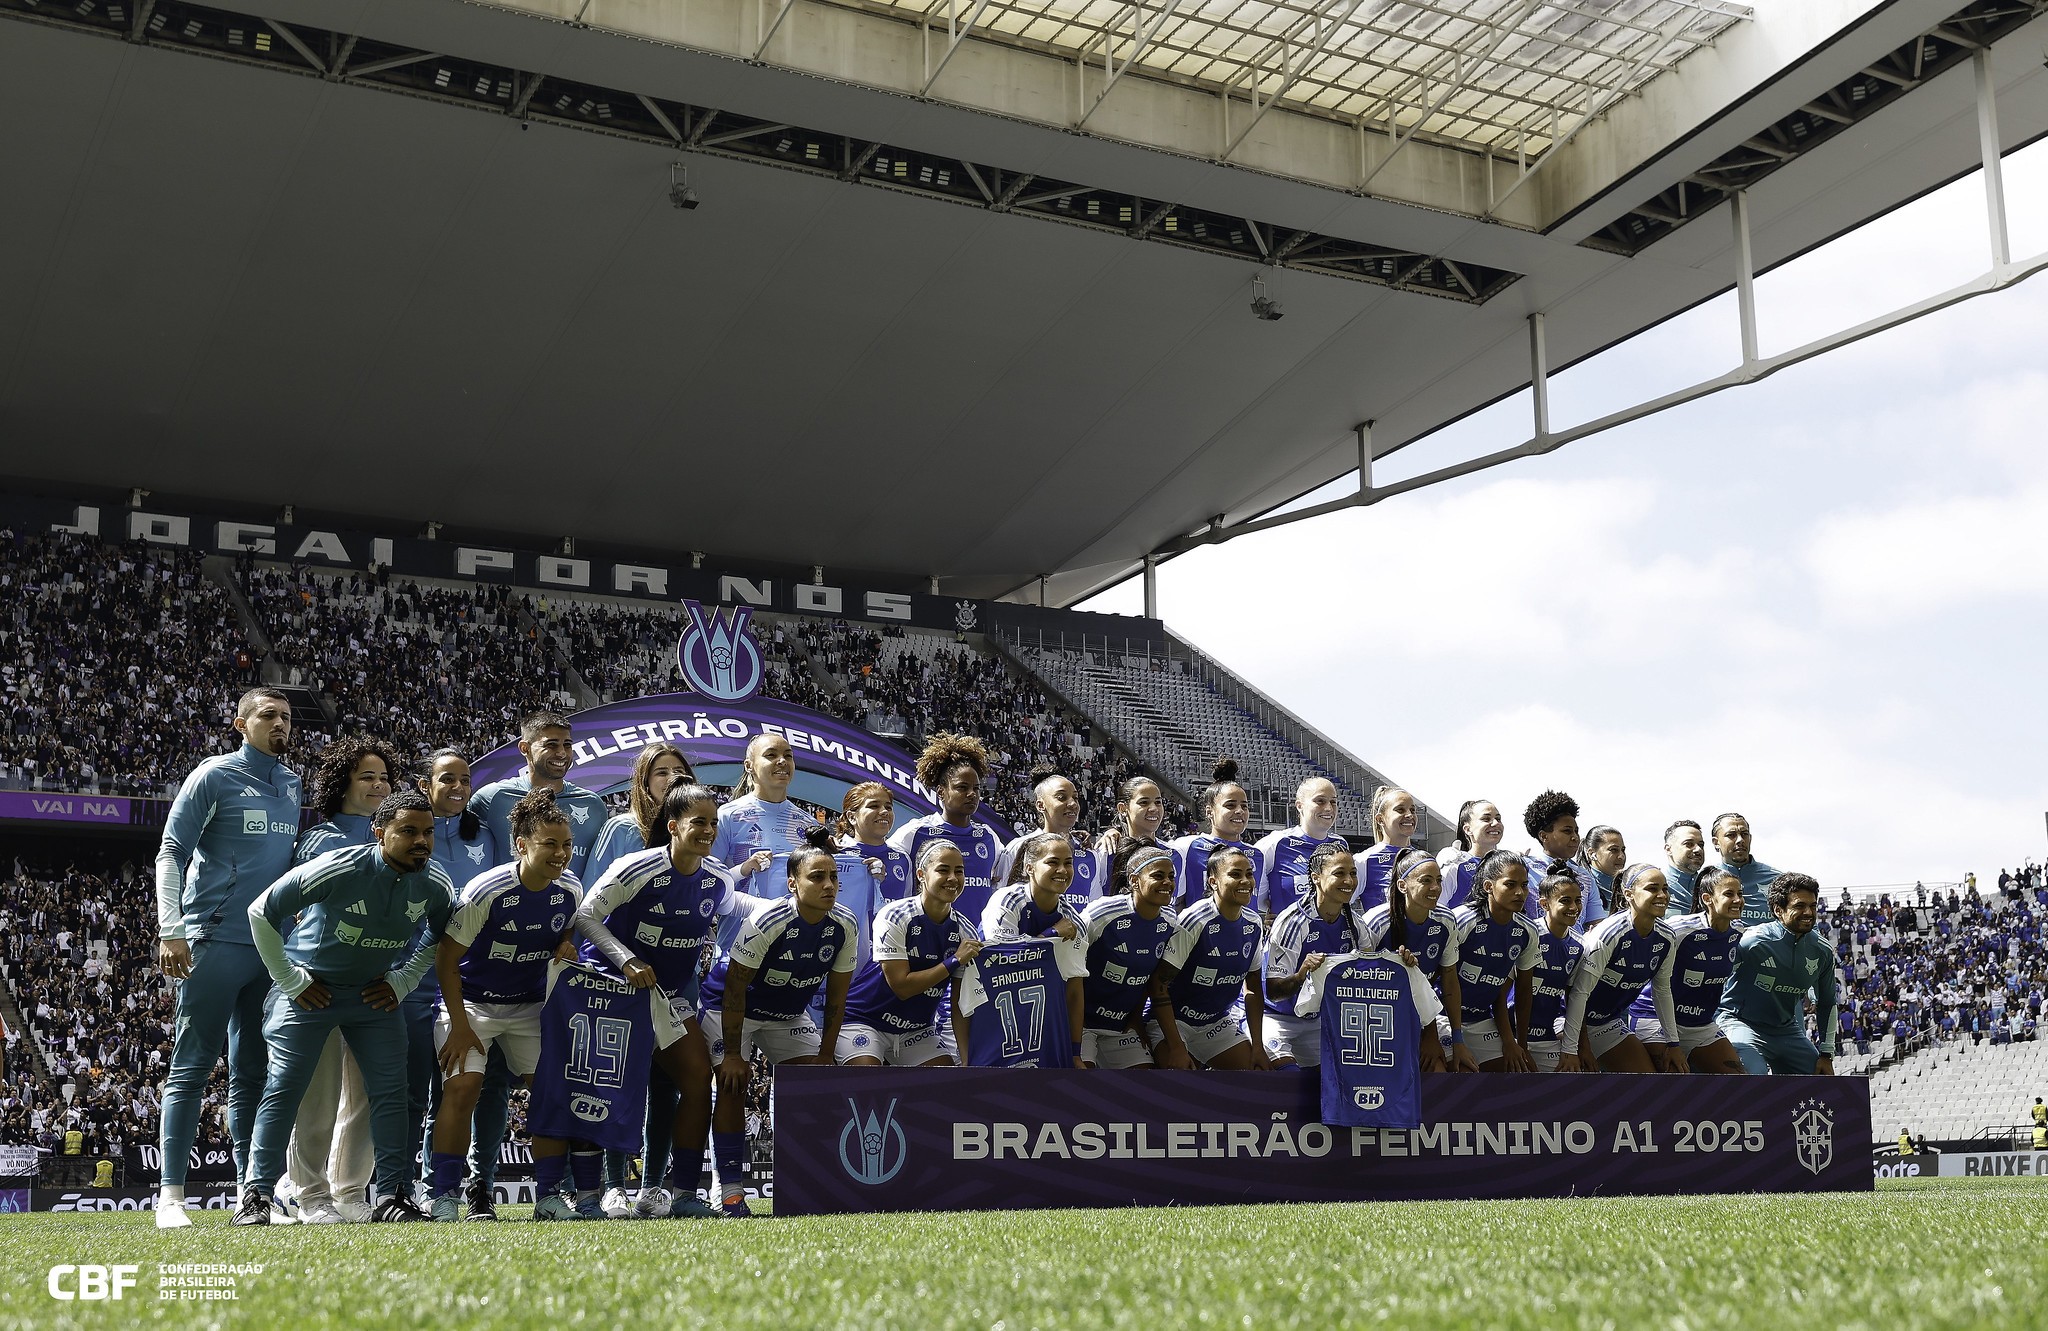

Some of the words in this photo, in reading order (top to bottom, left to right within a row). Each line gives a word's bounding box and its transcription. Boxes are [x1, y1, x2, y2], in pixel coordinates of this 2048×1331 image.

[51, 506, 393, 566] JOGAI
[457, 547, 668, 594] POR
[759, 721, 944, 809] FEMININ
[32, 800, 72, 814] VAI
[83, 802, 120, 817] NA
[998, 948, 1047, 965] betfair
[991, 968, 1045, 988] SANDOVAL
[1353, 967, 1395, 981] betfair
[1336, 987, 1353, 997] GIO
[1355, 988, 1399, 1000] OLIVEIRA
[587, 997, 611, 1010] LAY
[995, 985, 1046, 1058] 17
[1341, 1002, 1394, 1067] 92
[565, 1013, 632, 1088] 19
[1358, 1093, 1380, 1105] BH
[574, 1101, 605, 1118] BH
[953, 1112, 1333, 1160] BRASILEIRÃO
[1350, 1120, 1595, 1158] FEMININO
[1612, 1120, 1659, 1154] A1
[1673, 1120, 1766, 1154] 2025
[1807, 1136, 1821, 1144] CBF
[1965, 1155, 2030, 1177] BAIXE
